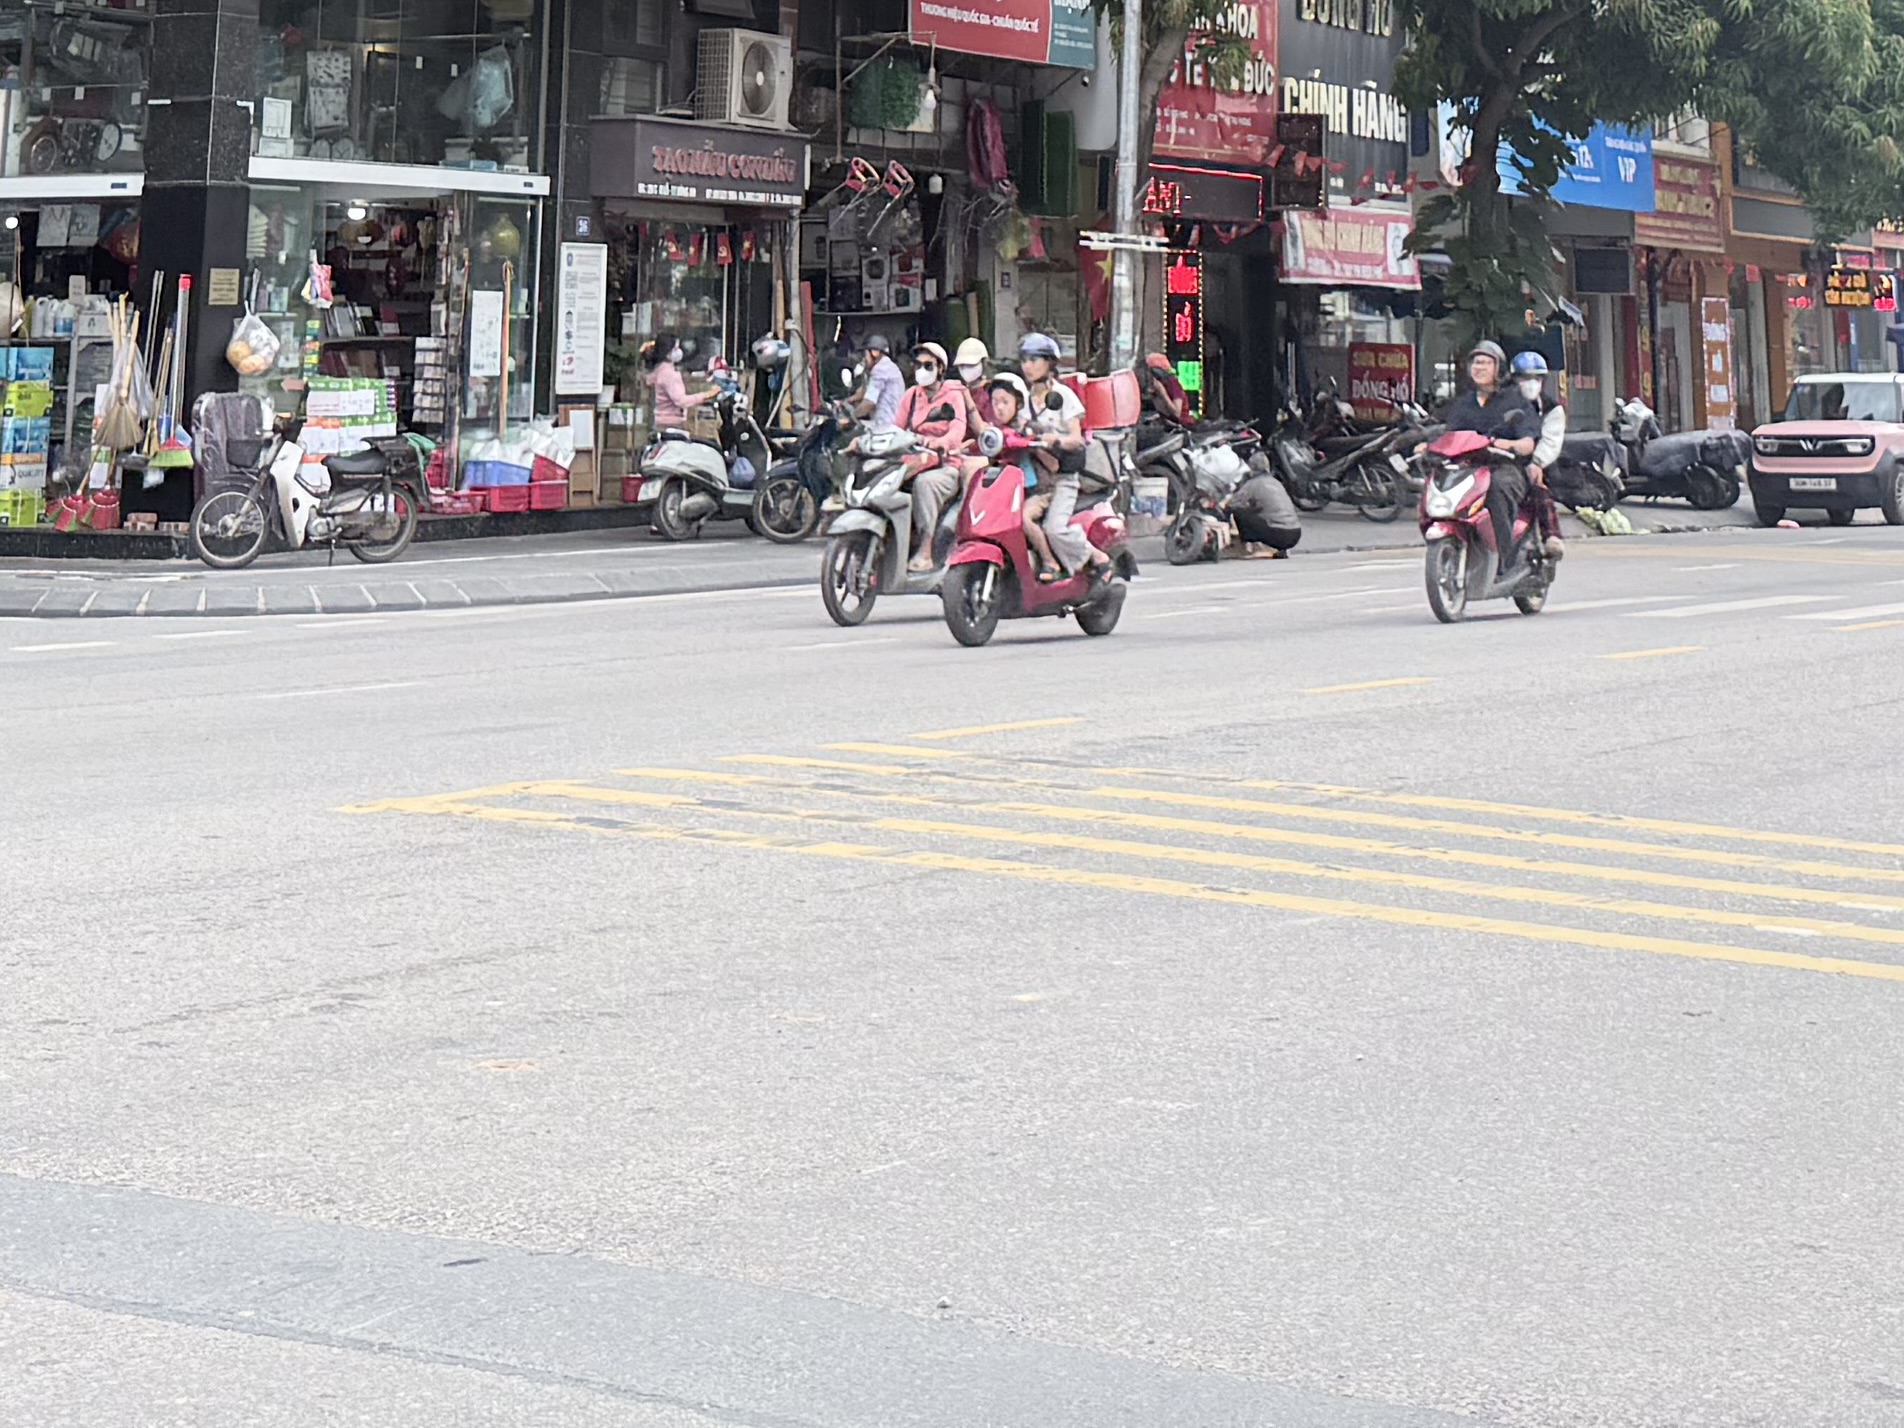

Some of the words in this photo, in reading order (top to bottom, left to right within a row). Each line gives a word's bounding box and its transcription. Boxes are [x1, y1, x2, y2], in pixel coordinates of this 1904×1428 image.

[1283, 69, 1348, 135] CHÍNH
[1352, 80, 1407, 143] HÀNG
[1617, 155, 1637, 183] VIP
